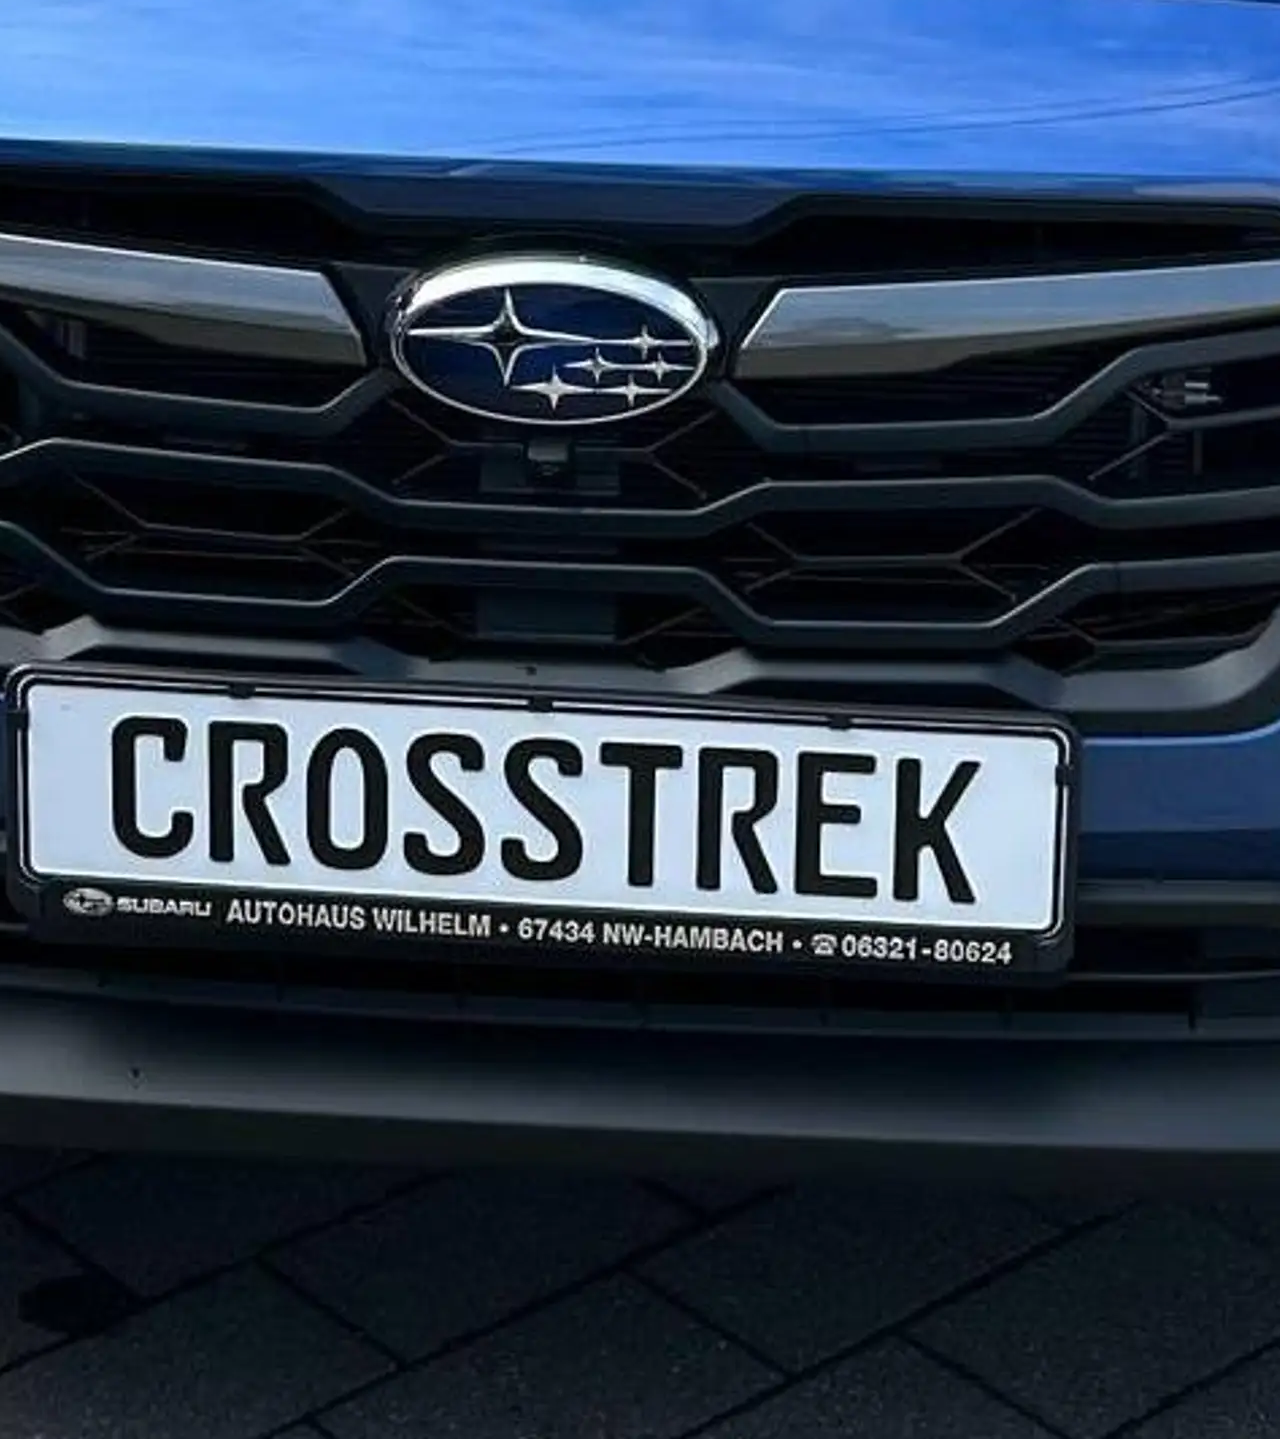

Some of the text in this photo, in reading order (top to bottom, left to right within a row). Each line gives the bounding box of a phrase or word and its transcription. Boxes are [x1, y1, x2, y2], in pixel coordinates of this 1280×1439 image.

[111, 715, 981, 904] CROSSTREK
[117, 896, 1012, 965] SUBARU AUTOHAUS WILHELM 67434 NW-HAMBACH 06321-80624
